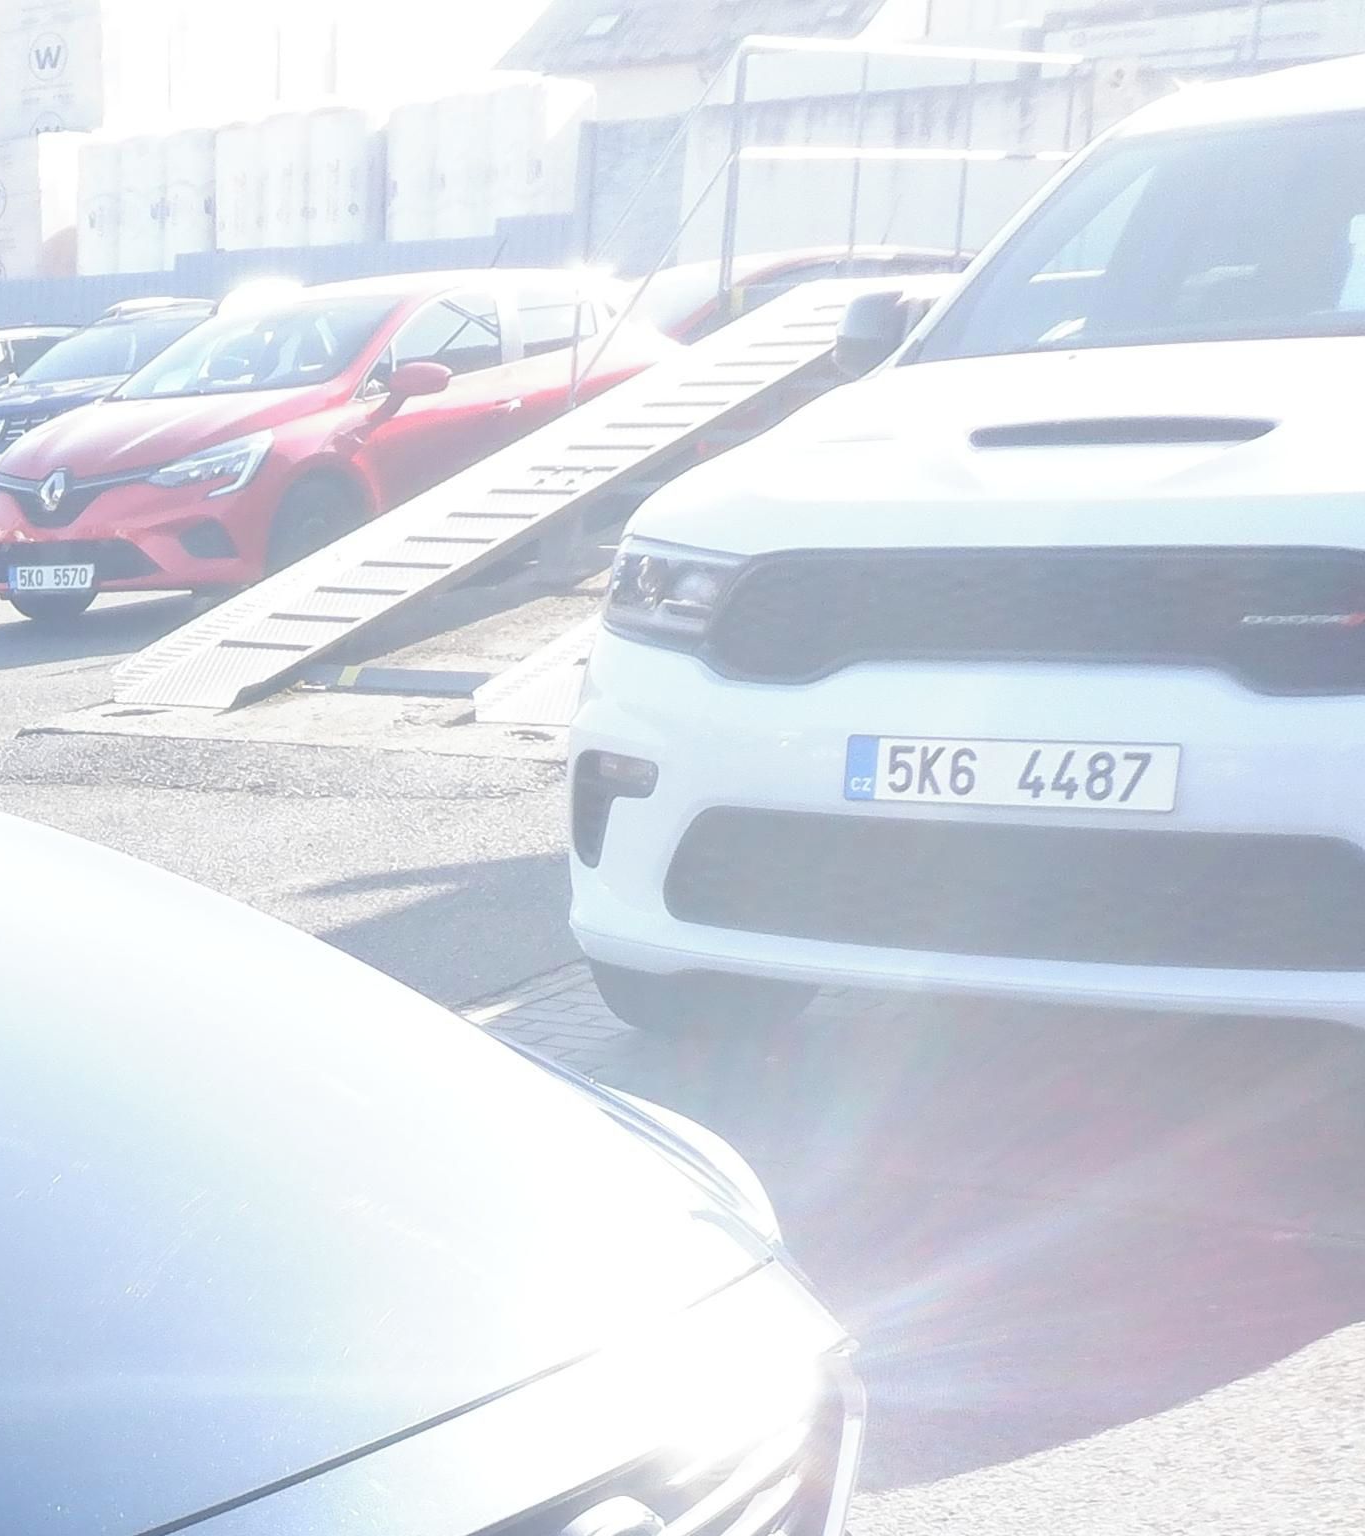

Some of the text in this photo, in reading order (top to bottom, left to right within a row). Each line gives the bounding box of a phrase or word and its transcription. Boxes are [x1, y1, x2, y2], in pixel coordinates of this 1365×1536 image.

[35, 44, 62, 70] W
[18, 567, 88, 588] 5K0 5570
[850, 776, 873, 793] CZ
[887, 745, 1153, 803] 5K6 4487
